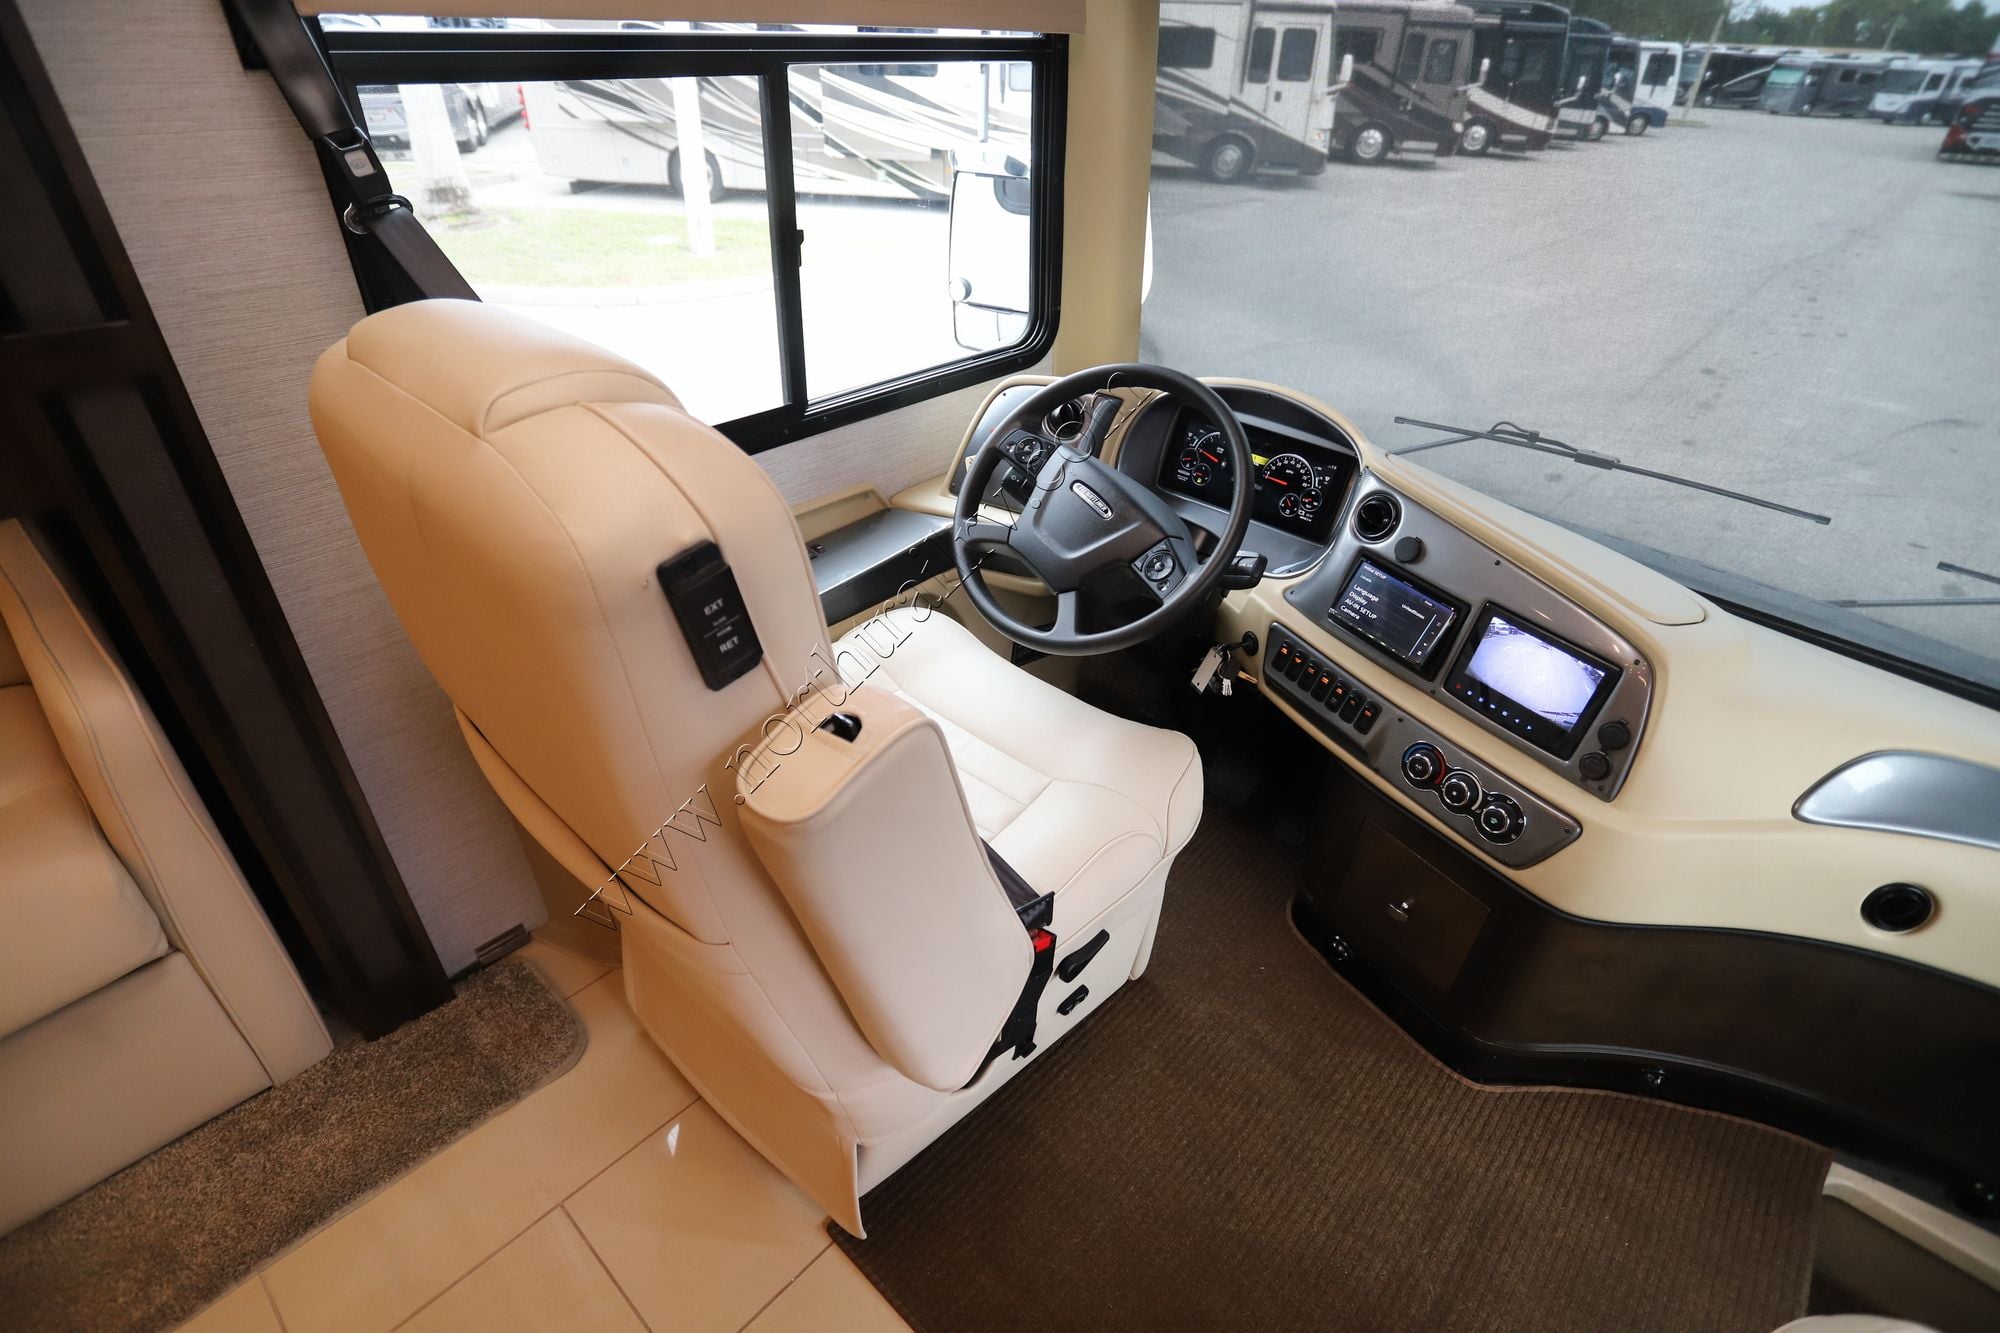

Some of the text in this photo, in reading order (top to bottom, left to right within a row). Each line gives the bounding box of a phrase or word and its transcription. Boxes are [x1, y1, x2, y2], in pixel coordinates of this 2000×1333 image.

[1375, 570, 1387, 579] SETUP
[1349, 591, 1368, 606] Display
[1354, 584, 1379, 602] Language
[703, 598, 724, 616] EXT
[1340, 605, 1360, 620] Camera
[1345, 598, 1377, 619] AV-IN SETUP
[719, 635, 740, 653] RET
